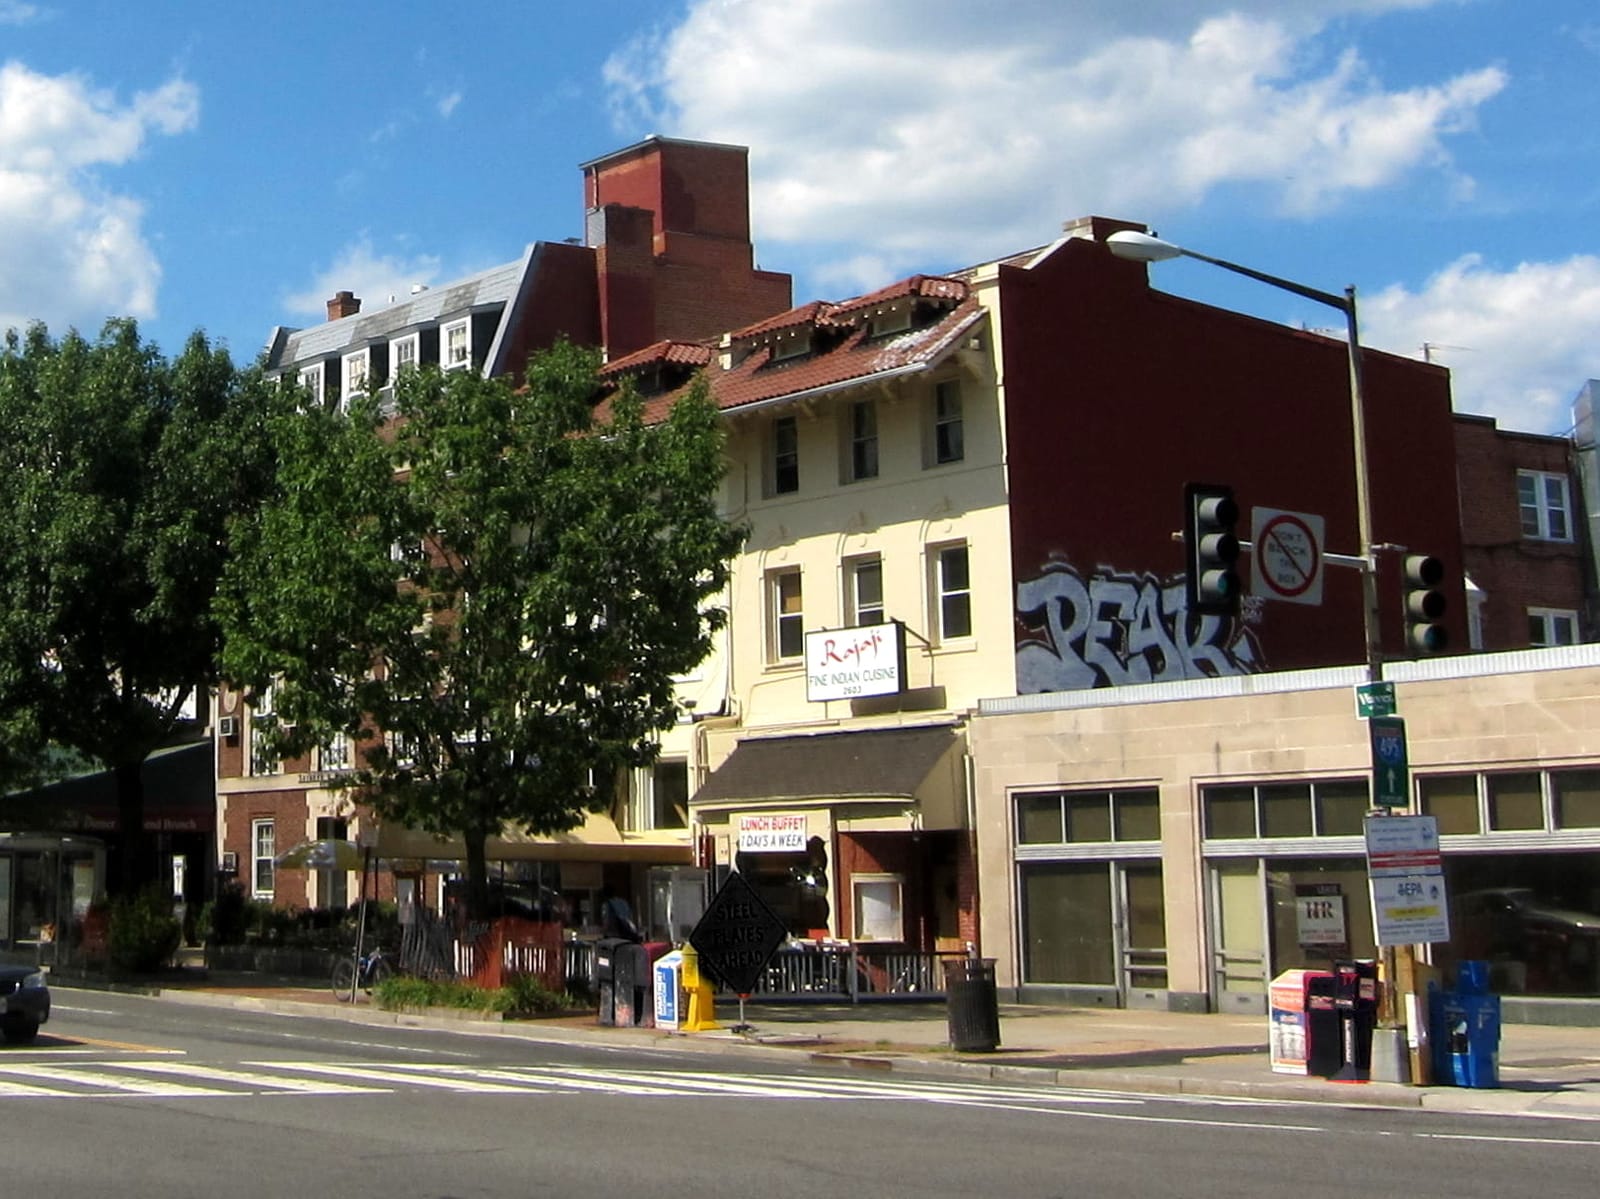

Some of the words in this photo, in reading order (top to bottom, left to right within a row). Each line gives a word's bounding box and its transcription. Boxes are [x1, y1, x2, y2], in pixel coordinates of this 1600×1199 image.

[820, 629, 882, 667] Rajaji
[809, 673, 828, 687] FINE
[831, 670, 860, 685] INDIAN
[863, 667, 895, 682] CUISINE
[741, 817, 769, 831] LUNCH
[772, 816, 804, 830] BUFFET
[746, 835, 768, 847] DAYS
[770, 834, 776, 847] A
[778, 834, 803, 847] WEEK
[715, 901, 758, 921] STEEL
[712, 927, 765, 946] PLATES
[717, 950, 764, 969] AHEAD
